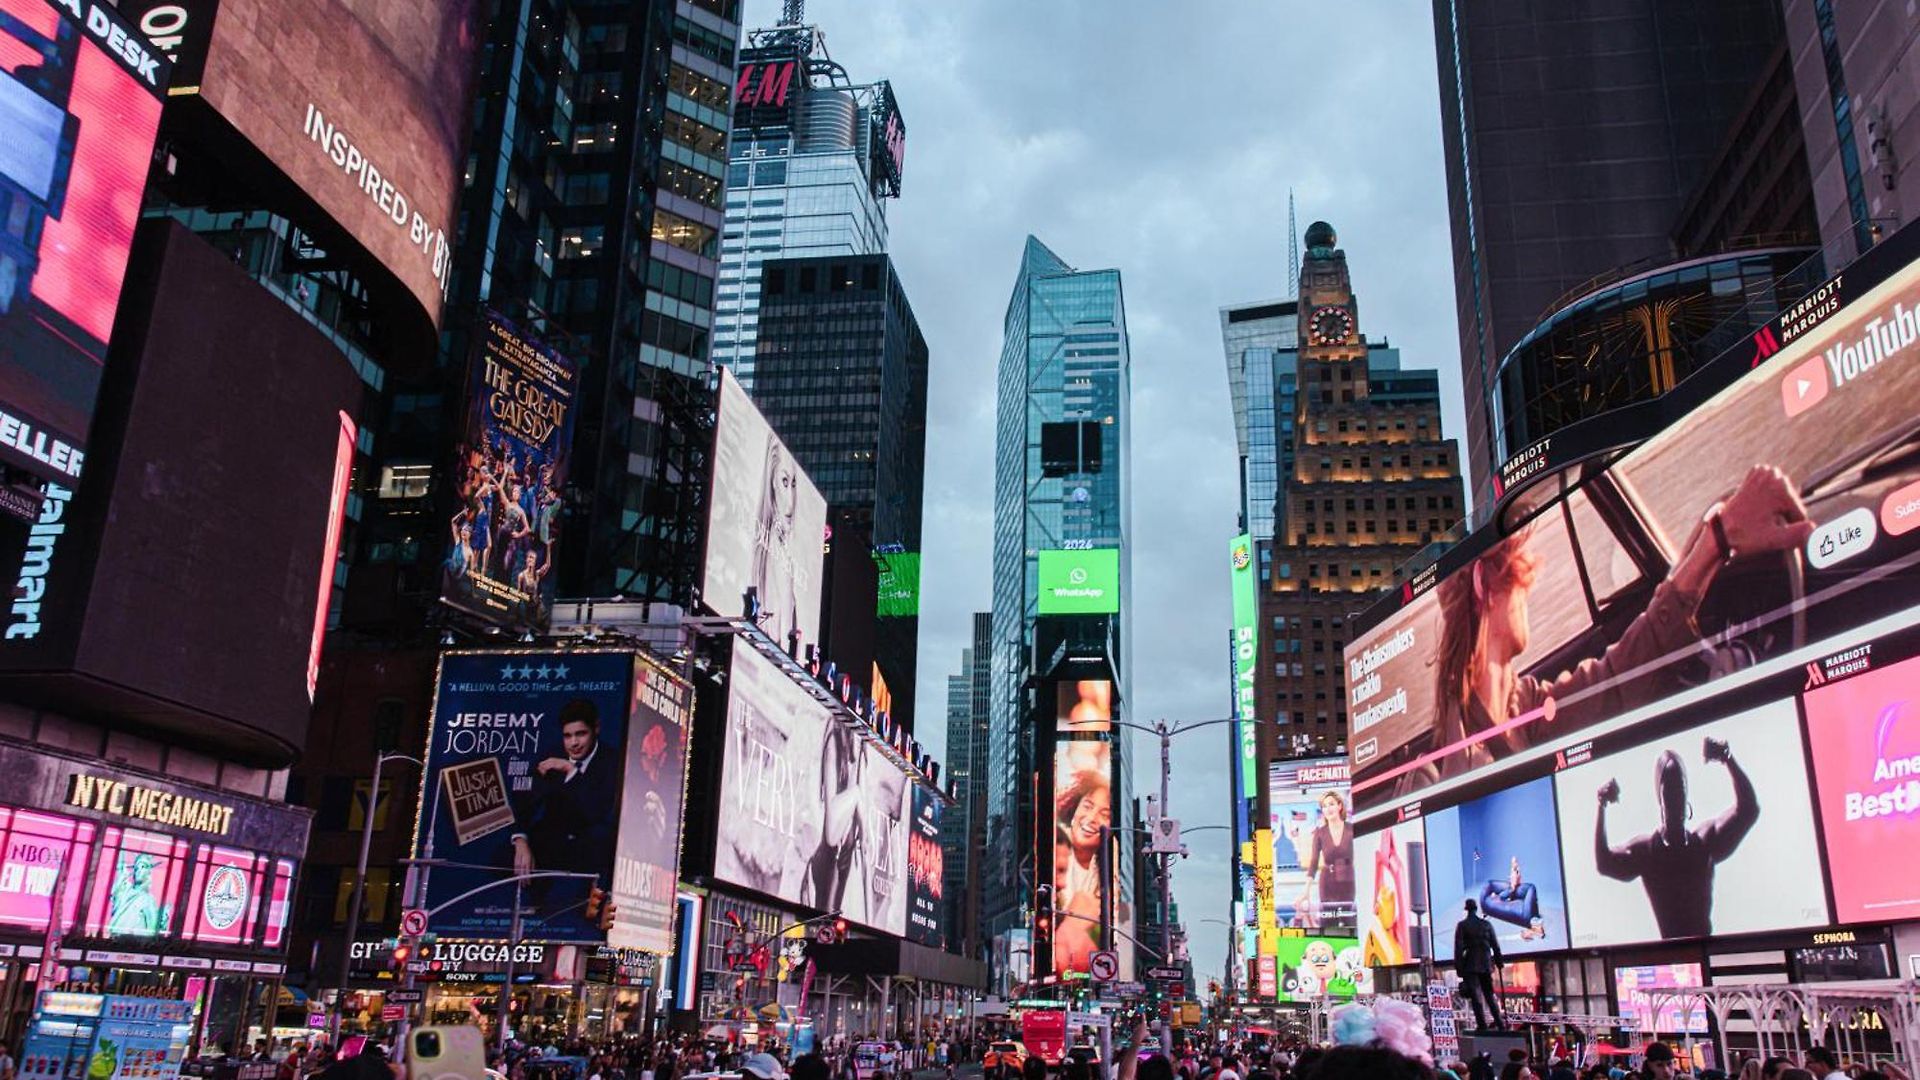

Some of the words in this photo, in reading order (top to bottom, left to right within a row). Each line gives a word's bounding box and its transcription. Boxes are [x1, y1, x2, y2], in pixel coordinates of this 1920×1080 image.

[86, 4, 160, 86] DESK
[304, 103, 408, 225] INSPIRED
[411, 211, 434, 254] BY
[1781, 276, 1843, 327] MARRIOTT
[1782, 297, 1838, 343] MARQUIS
[504, 342, 557, 382] EXTRAVAGANZA
[536, 352, 573, 381] BROADWAY
[485, 356, 513, 396] THE
[515, 379, 567, 428] GREAT
[490, 392, 555, 443] GATSBY
[0, 411, 85, 478] ELLER
[1503, 438, 1551, 476] MARRIOTT
[1505, 456, 1545, 490] MARQUIS
[1063, 540, 1093, 550] 2026
[1839, 526, 1862, 545] Like
[1413, 563, 1438, 585] MARRIOTT
[1414, 576, 1436, 595] MARQUIS
[1054, 587, 1104, 598] WhatsApp
[1237, 627, 1254, 660] 50
[1825, 645, 1872, 669] MARRIOTT
[1827, 658, 1868, 679] MARQUIS
[459, 682, 496, 692] HELLUVA
[499, 682, 529, 693] GOOD
[531, 682, 551, 692] TIME
[448, 713, 544, 728] JEREMY
[1239, 665, 1256, 760] YEARS
[443, 730, 540, 754] JORDAN
[454, 770, 486, 796] JUST
[71, 774, 124, 815] NYC
[129, 786, 234, 835] MEGAMART
[454, 784, 504, 814] TIME
[1813, 931, 1856, 944] SEPHORA
[433, 944, 544, 963] LUGGAGE
[445, 973, 477, 981] SONY
[124, 984, 179, 999] LUGGAGE
[1429, 986, 1448, 996] ONLY
